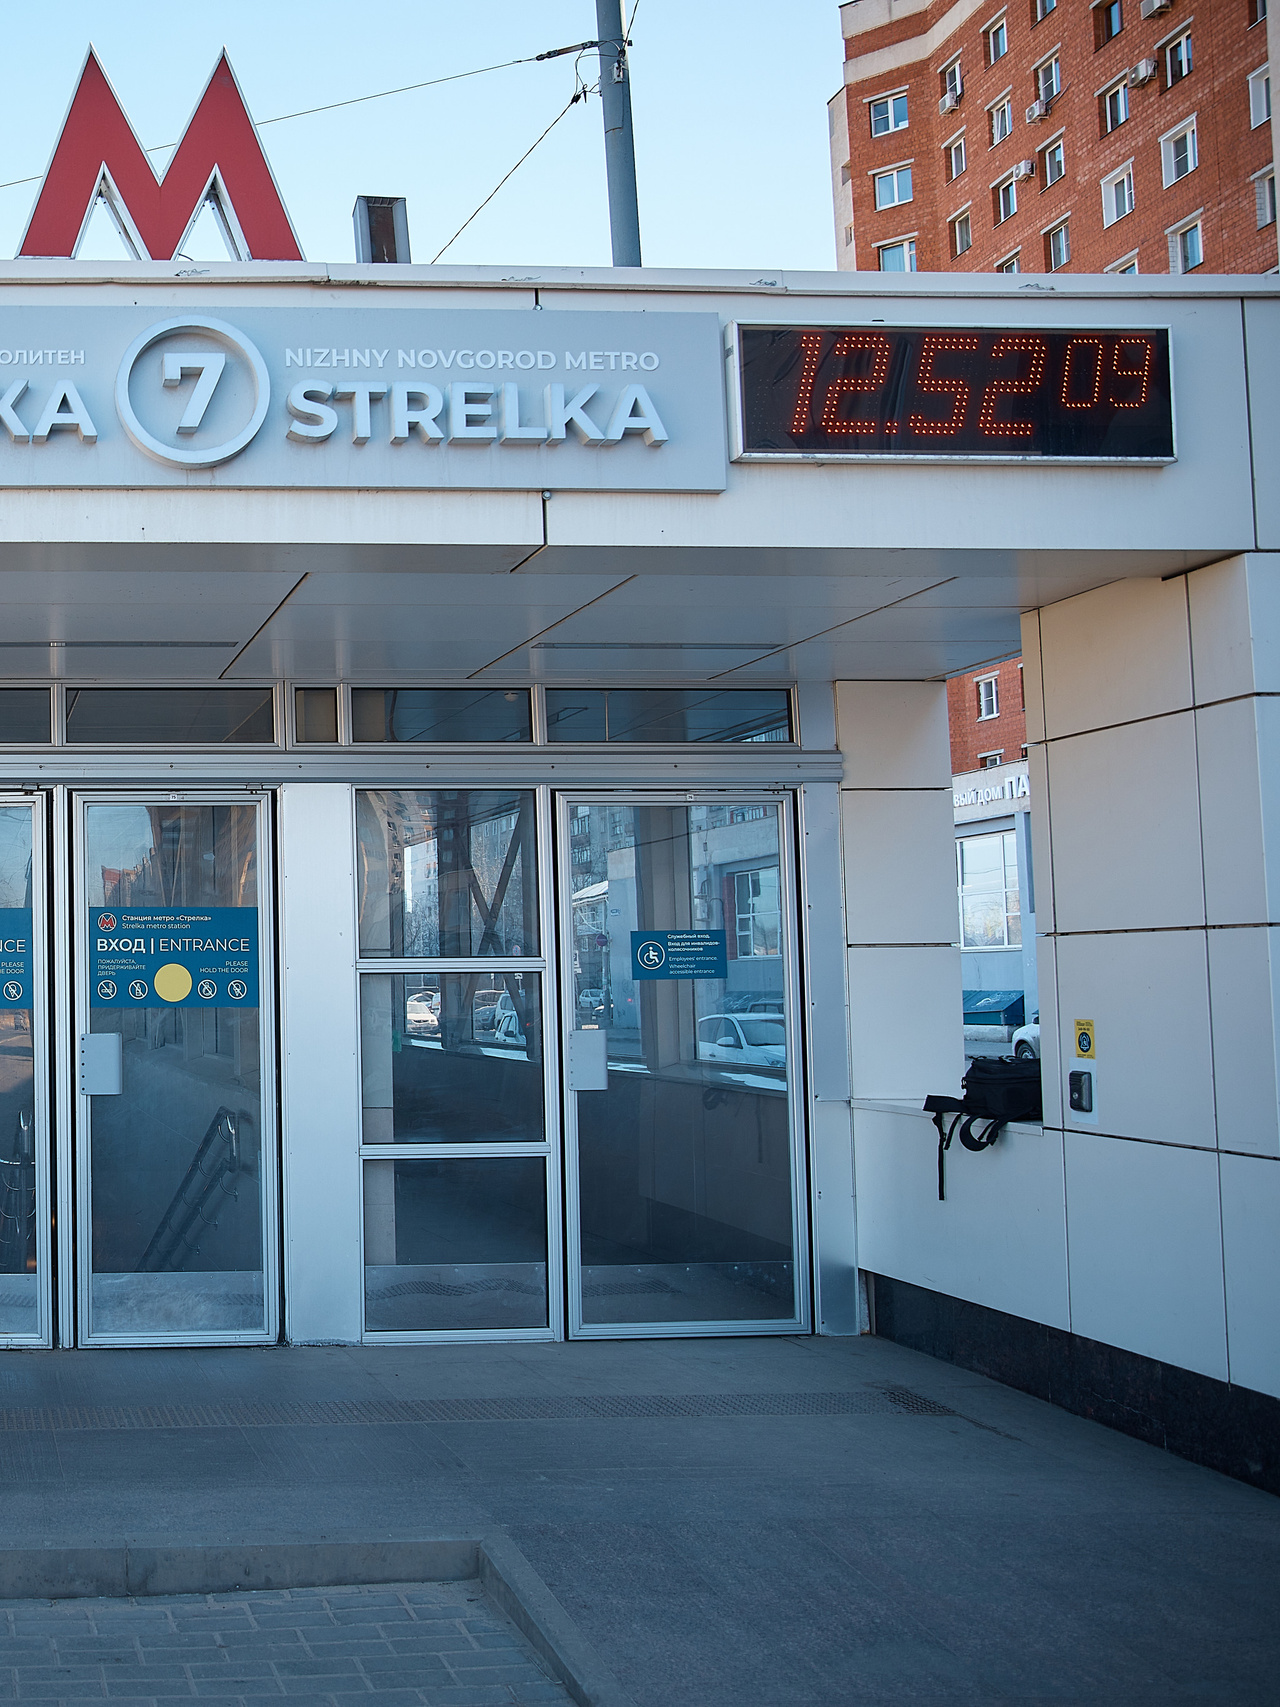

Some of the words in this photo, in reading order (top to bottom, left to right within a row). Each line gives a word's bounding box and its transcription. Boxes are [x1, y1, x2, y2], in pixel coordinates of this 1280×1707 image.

[285, 348, 389, 368] NIZHNY
[398, 349, 556, 370] NOVGOROD
[565, 351, 659, 371] METRO
[1060, 338, 1152, 408] 09
[161, 353, 225, 434] 7
[286, 379, 668, 447] STRELKA
[1005, 775, 1030, 800] ПА
[97, 938, 145, 954] ВХОД
[160, 938, 250, 951] ENTRANCE
